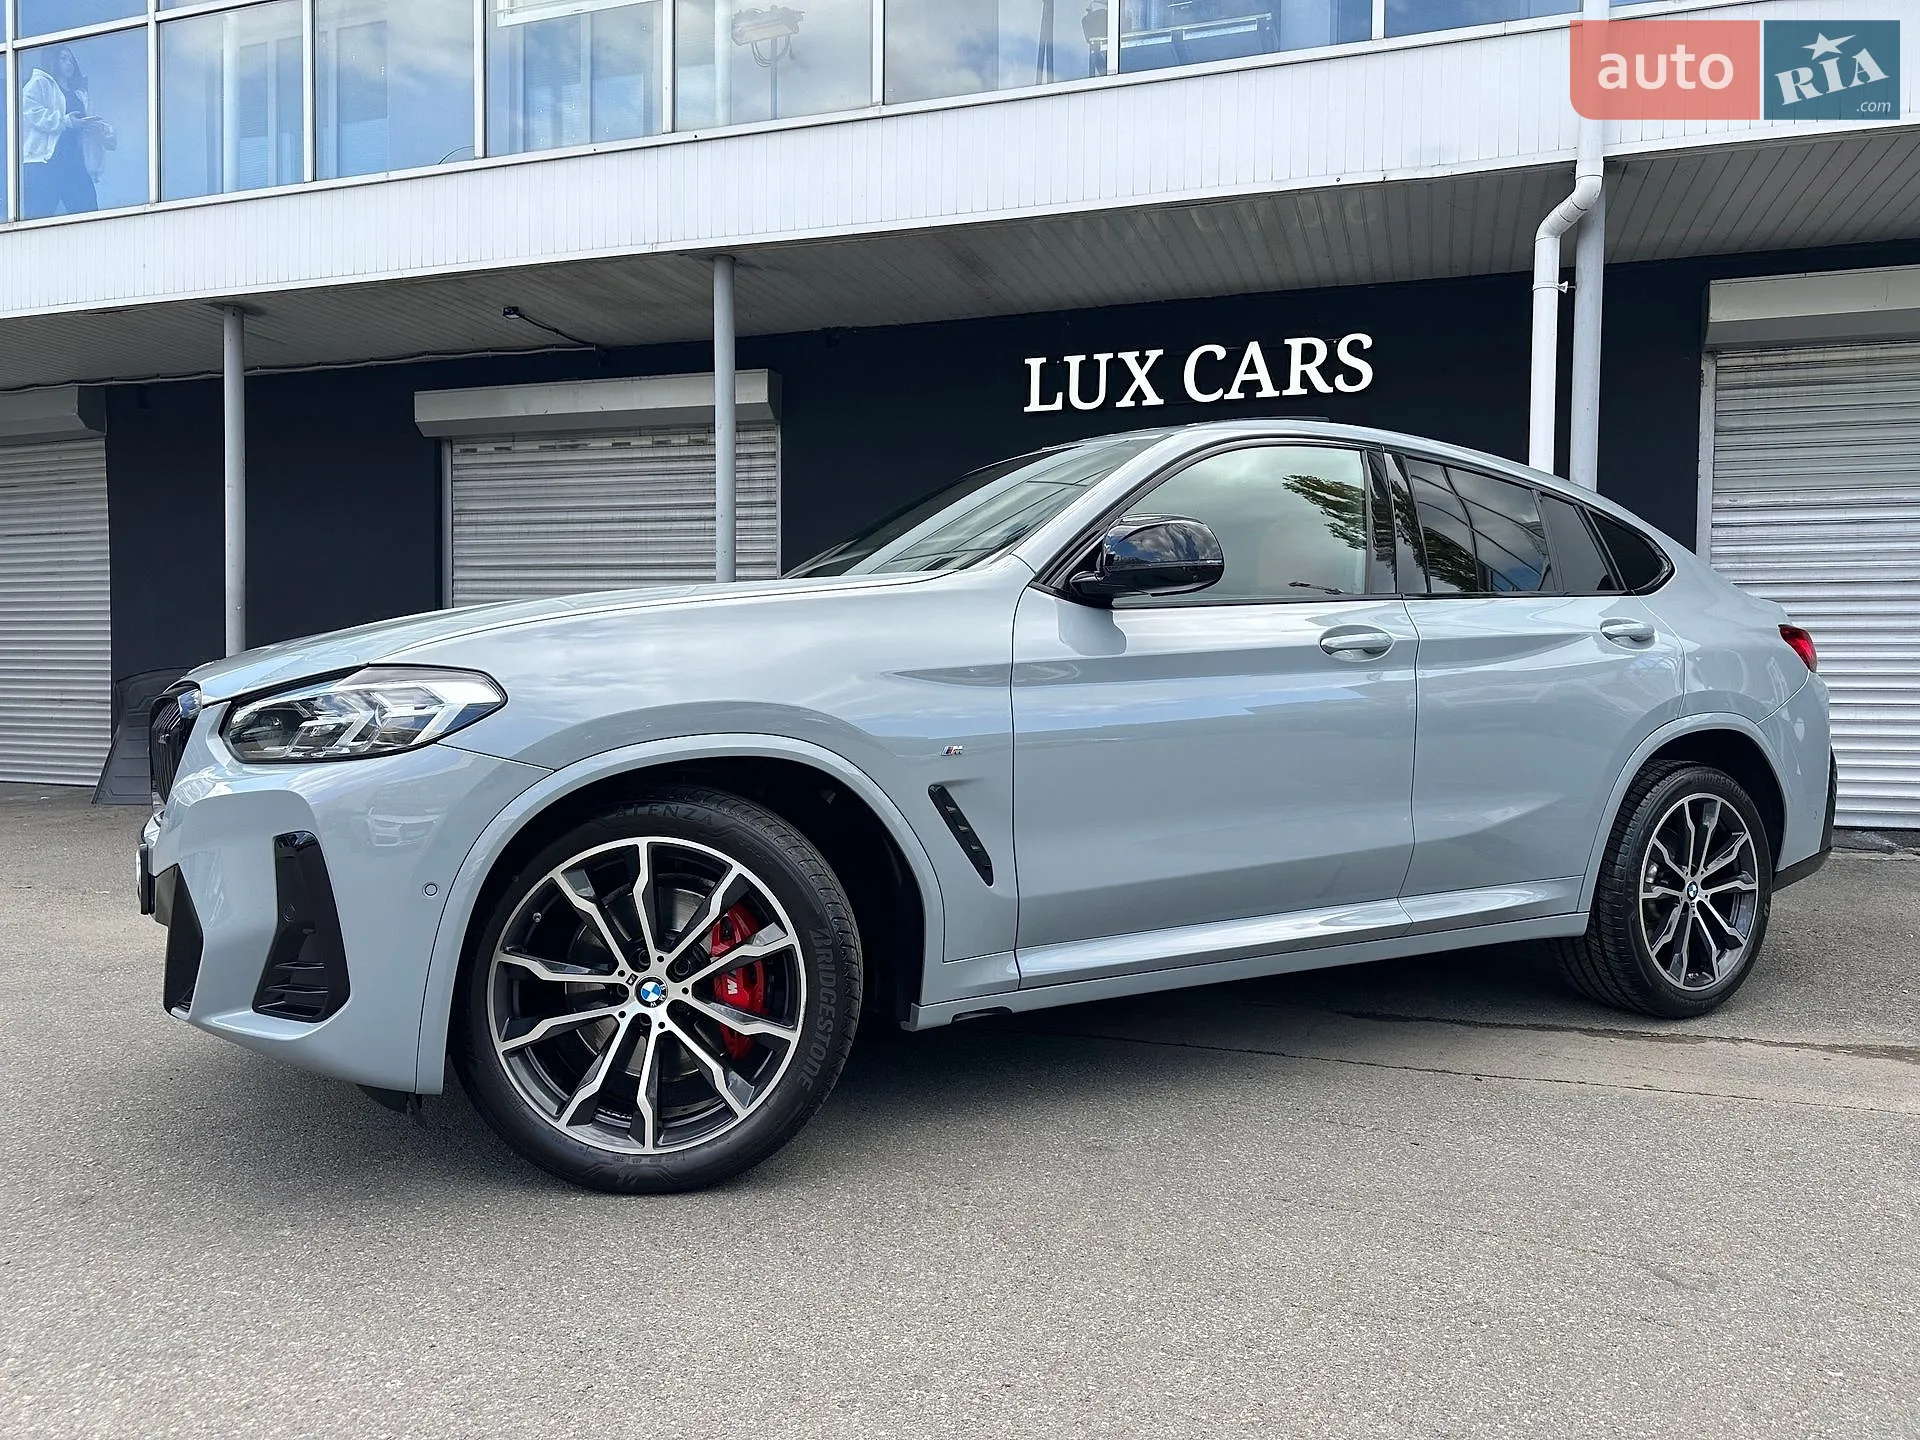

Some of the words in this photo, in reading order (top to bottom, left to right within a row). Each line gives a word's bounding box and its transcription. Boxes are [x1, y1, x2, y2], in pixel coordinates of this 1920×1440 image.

[1024, 349, 1164, 412] LUX
[1183, 332, 1374, 403] CARS
[796, 927, 838, 1091] BRIDGESTONE
